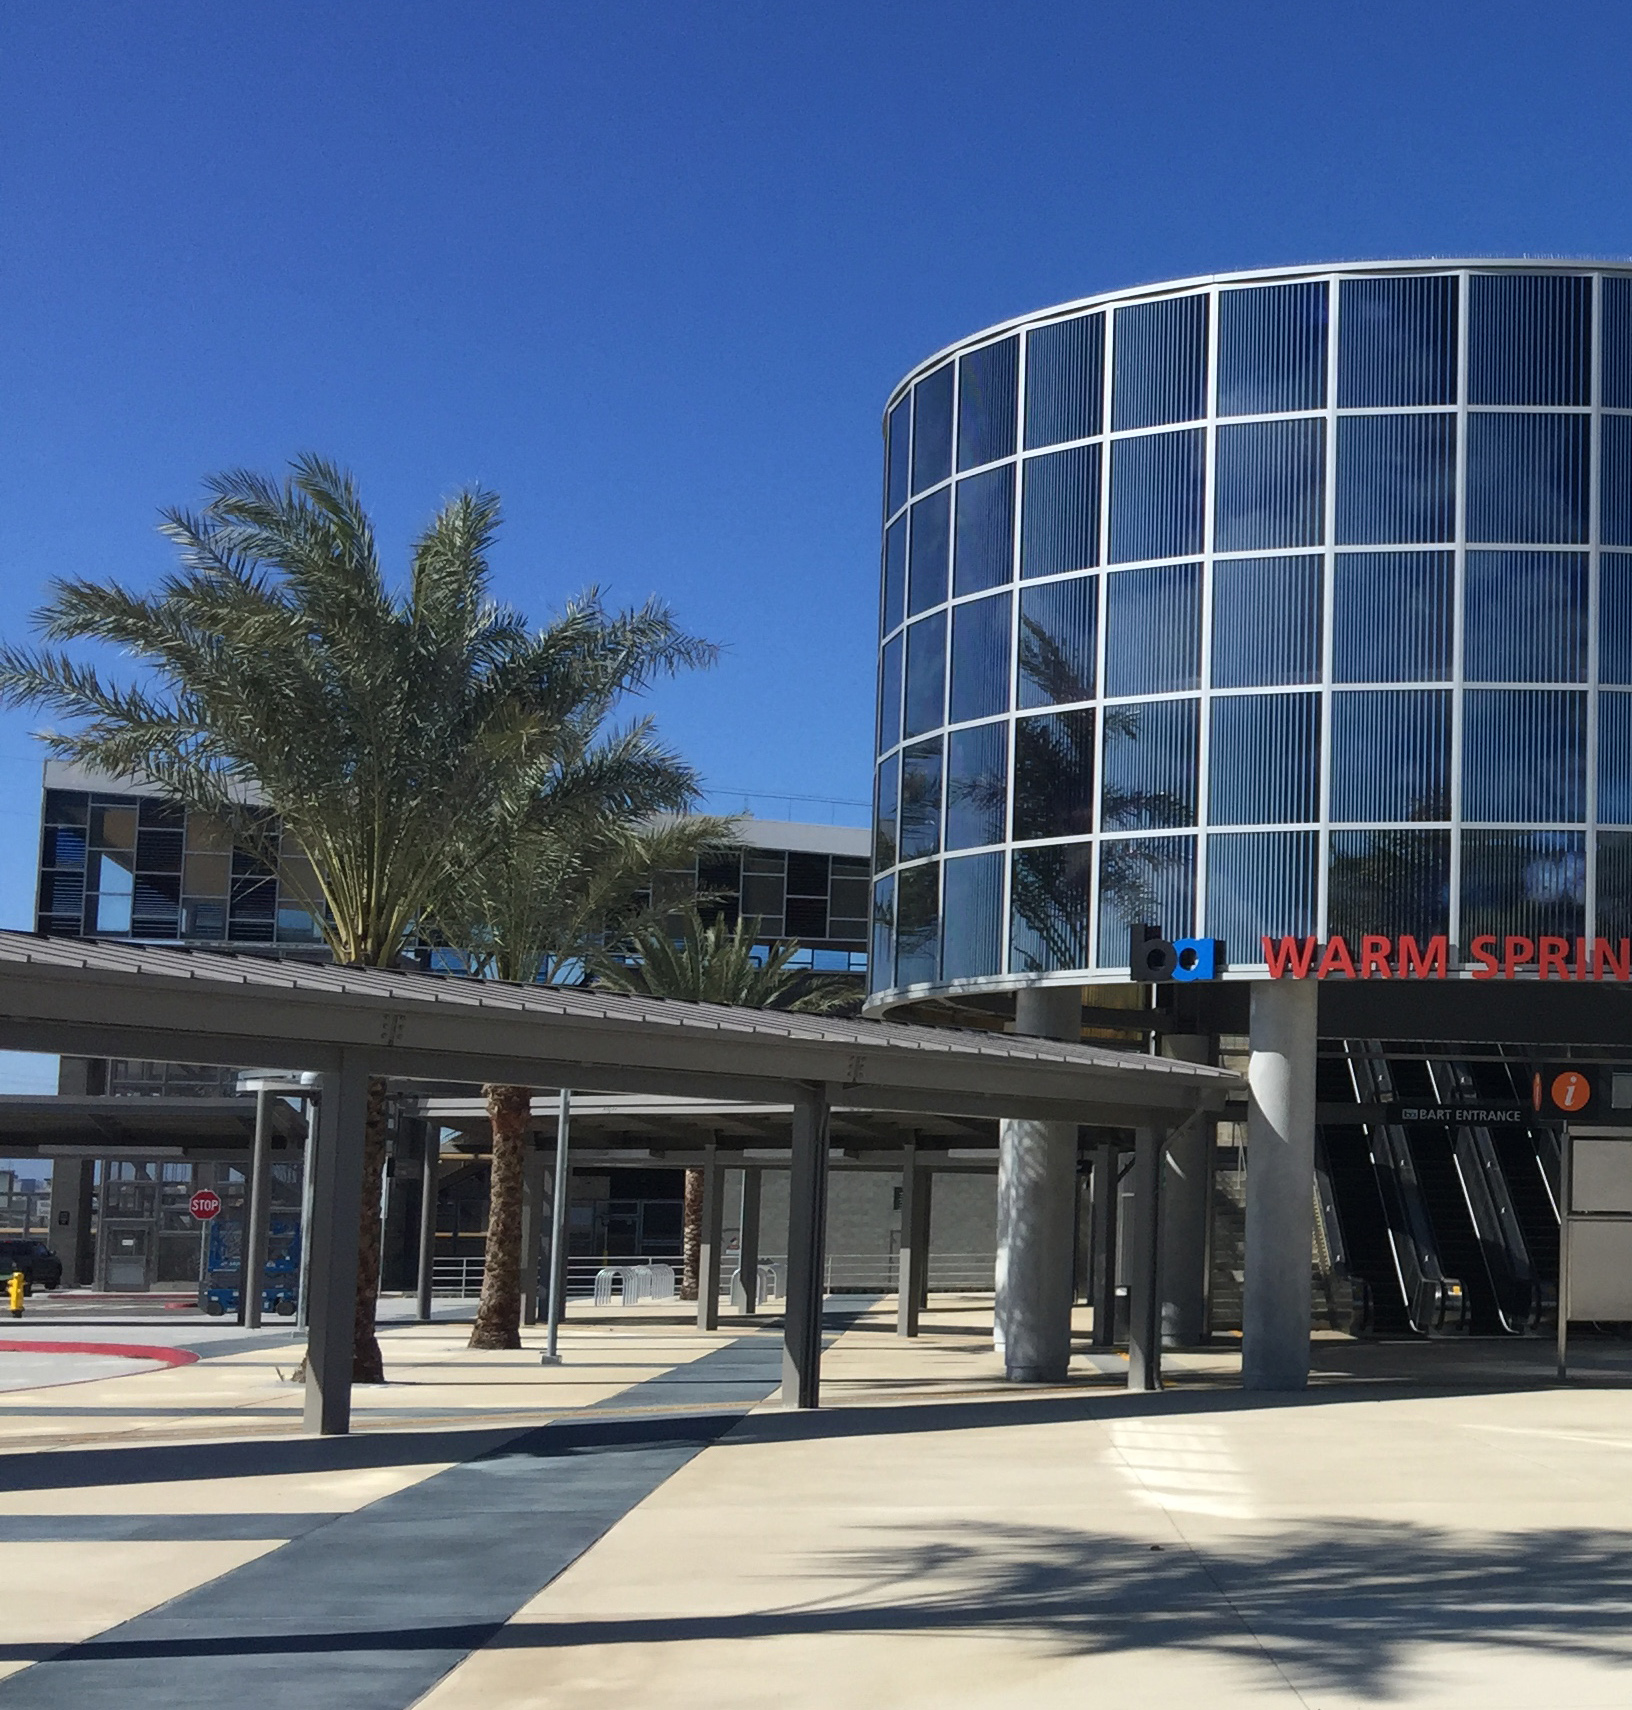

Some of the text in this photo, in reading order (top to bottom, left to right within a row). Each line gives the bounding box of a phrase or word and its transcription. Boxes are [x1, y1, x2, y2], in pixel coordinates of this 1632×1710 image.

[1261, 935, 1447, 980] WARM
[1419, 1109, 1452, 1120] BART
[1455, 1109, 1521, 1122] ENTRANCE
[192, 1200, 219, 1211] STOP
